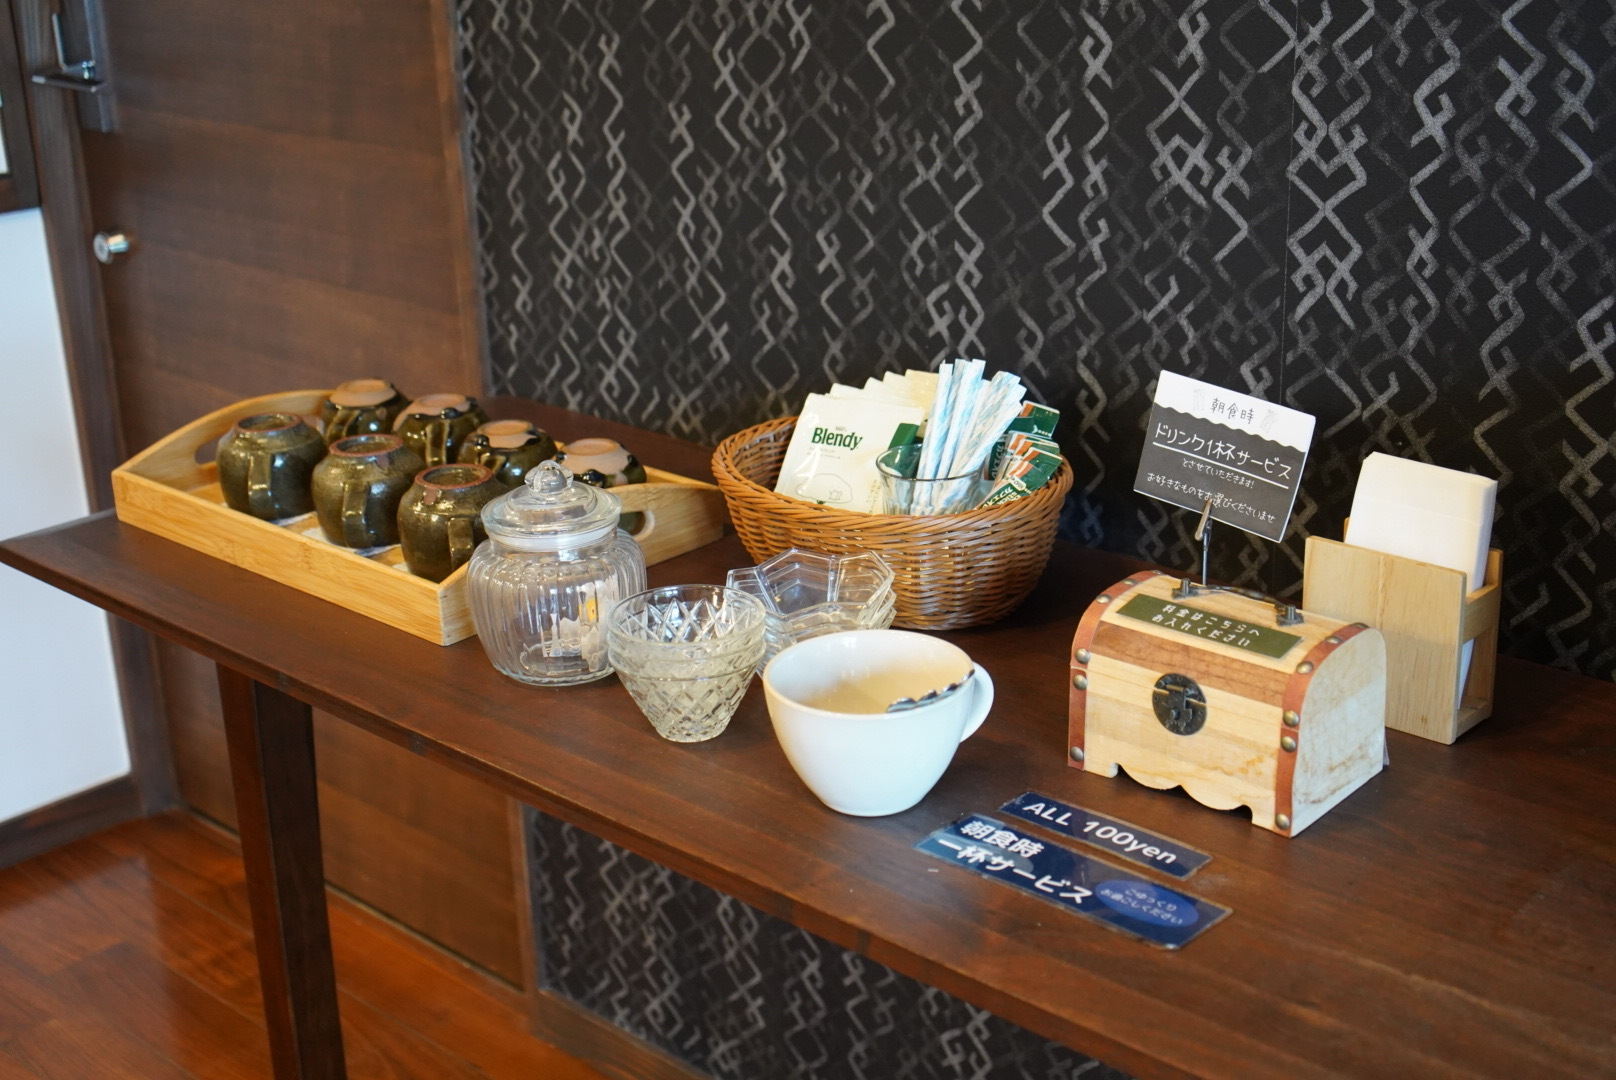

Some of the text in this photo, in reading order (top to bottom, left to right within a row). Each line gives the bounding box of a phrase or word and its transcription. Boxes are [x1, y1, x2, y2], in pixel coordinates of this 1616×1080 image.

[1210, 398, 1255, 424] 朝食時
[811, 427, 864, 451] Blendy
[1155, 422, 1292, 480] ドリンク1杯サービス
[1147, 472, 1275, 524] お好きなものをお選びくださいませ
[1151, 614, 1251, 647] お入れください
[1162, 604, 1260, 637] 料金はこちらへ
[959, 820, 1045, 859] 朝食時
[1022, 802, 1177, 865] ALL 100yen
[937, 838, 1094, 905] 一杯サービス
